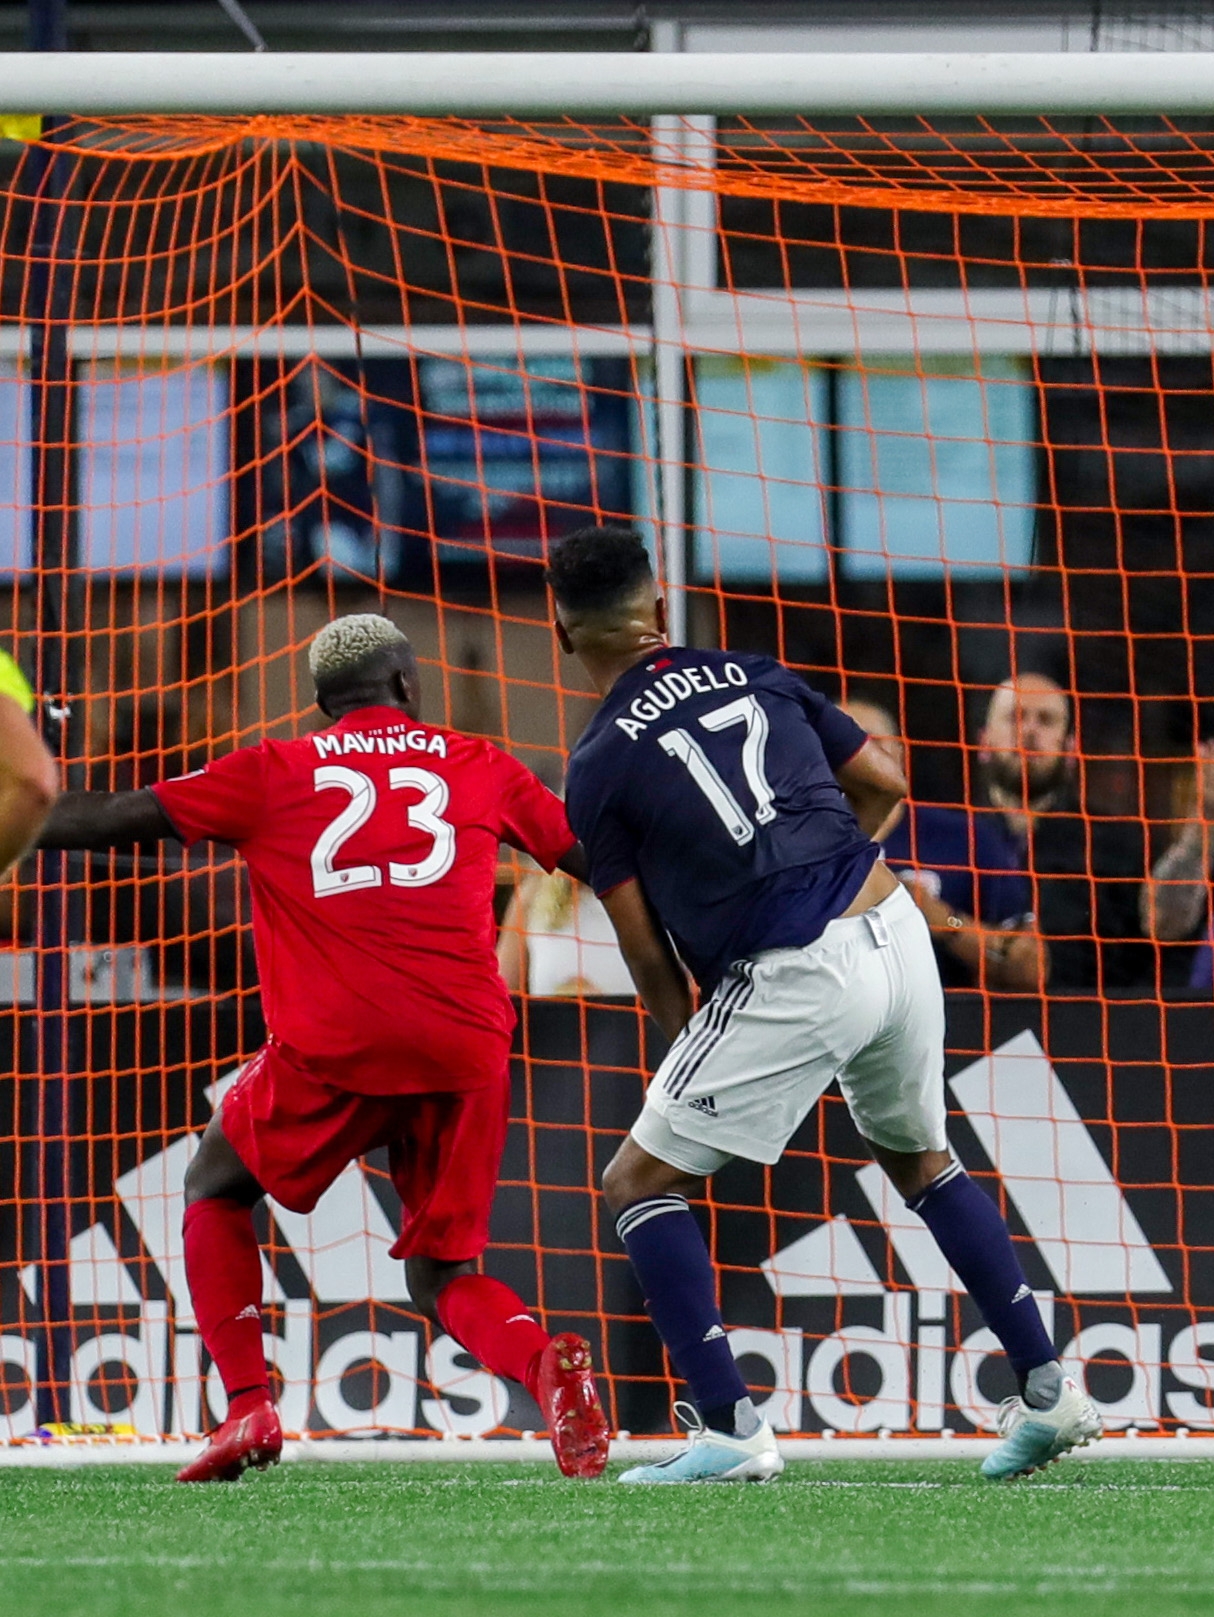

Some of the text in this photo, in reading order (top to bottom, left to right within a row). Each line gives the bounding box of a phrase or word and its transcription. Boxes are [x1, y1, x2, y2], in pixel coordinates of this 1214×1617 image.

[312, 729, 448, 760] MAVINGA
[614, 662, 749, 742] AGUDELO
[656, 693, 778, 847] 17
[310, 764, 457, 899] 23
